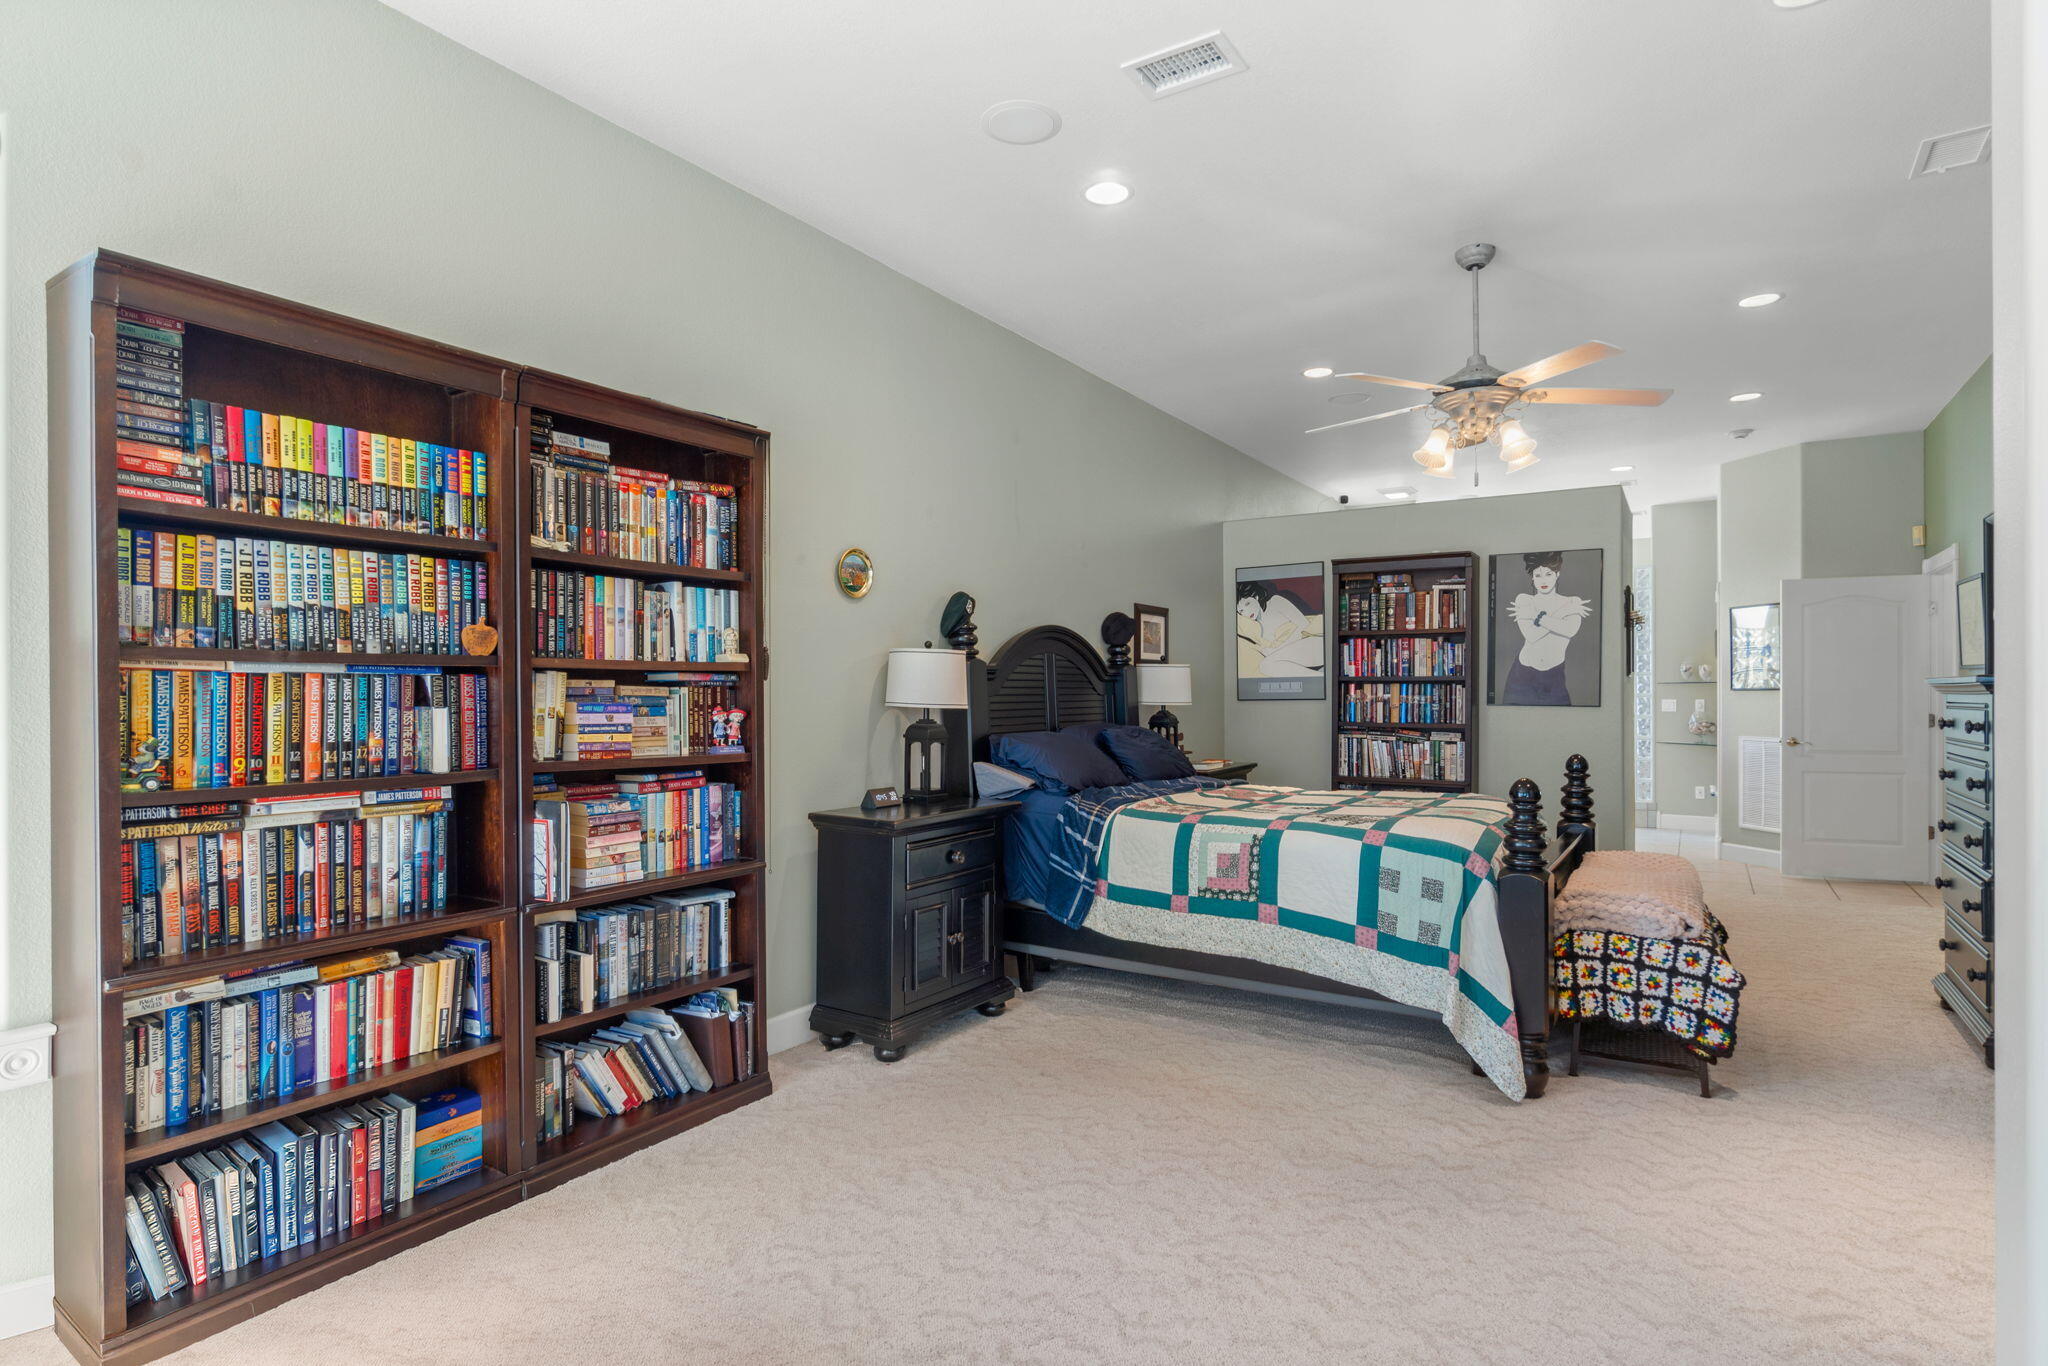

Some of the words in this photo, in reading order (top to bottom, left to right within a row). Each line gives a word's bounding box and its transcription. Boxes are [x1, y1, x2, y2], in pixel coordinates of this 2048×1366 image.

[361, 459, 371, 479] ROBB
[406, 464, 414, 484] ROBB
[462, 473, 471, 493] ROBB
[137, 559, 151, 582] ROBB
[182, 563, 193, 586] ROBB
[200, 562, 213, 586] ROBB
[220, 568, 232, 590] ROBB
[157, 676, 169, 704] JAMES
[178, 675, 189, 704] JAMES
[201, 675, 210, 704] JAMES
[216, 676, 227, 704] JAMES
[235, 676, 244, 703] JAMES
[252, 676, 262, 704] JAMES
[272, 676, 281, 702] JAMES
[292, 678, 300, 700] JAMES
[311, 679, 319, 700] JAMES
[328, 679, 336, 700] JAMES
[343, 679, 351, 700] JAMES
[374, 678, 382, 699] JAMES
[464, 676, 473, 696] ROSES
[465, 698, 474, 709] ARE
[273, 704, 282, 752] PATTERSON
[291, 702, 301, 743] PATTERSON
[310, 702, 319, 743] PATTERSON
[327, 702, 336, 742] PATTERSON
[343, 702, 352, 742] PATTERSON
[359, 700, 367, 740] PATTERSON
[374, 701, 382, 739] PATTERSON
[403, 711, 412, 725] KISS
[466, 711, 474, 723] RED
[157, 706, 169, 760] PATTERSON
[179, 706, 189, 757] PATTERSON
[201, 706, 210, 757] PATTERSON
[217, 705, 227, 756] PATTERSON
[235, 705, 245, 756] PATTERSON
[252, 705, 262, 755] PATTERSON
[403, 726, 412, 738] THE
[403, 739, 412, 756] GIRLS
[465, 728, 475, 765] PATTERSON
[378, 792, 394, 801] JAMES
[395, 790, 422, 799] PATTERSON
[126, 807, 166, 820] PATTERSON
[180, 806, 200, 816] THE
[201, 804, 228, 815] CHEF
[128, 823, 188, 839] PATTERSON
[190, 820, 228, 834] Writer
[206, 838, 217, 854] JAMES
[207, 854, 218, 882] PATTERSON
[403, 864, 411, 880] CROSS
[208, 886, 218, 910] DOUBLE
[228, 882, 238, 906] CROSS
[266, 884, 276, 900] ALEX
[285, 875, 294, 898] CROSS
[143, 897, 156, 913] JAMES
[166, 892, 179, 913] MARY
[267, 902, 277, 926] CROSS
[285, 900, 295, 915] FIRE
[353, 896, 362, 913] HEART
[143, 913, 156, 943] PATTERSON
[167, 915, 180, 937] MARY
[186, 904, 200, 933] CROSS
[208, 910, 218, 934] CROSS
[228, 906, 239, 935] COUNTRY
[210, 1024, 220, 1053] SHELDON
[126, 1065, 134, 1095] SHELDON
